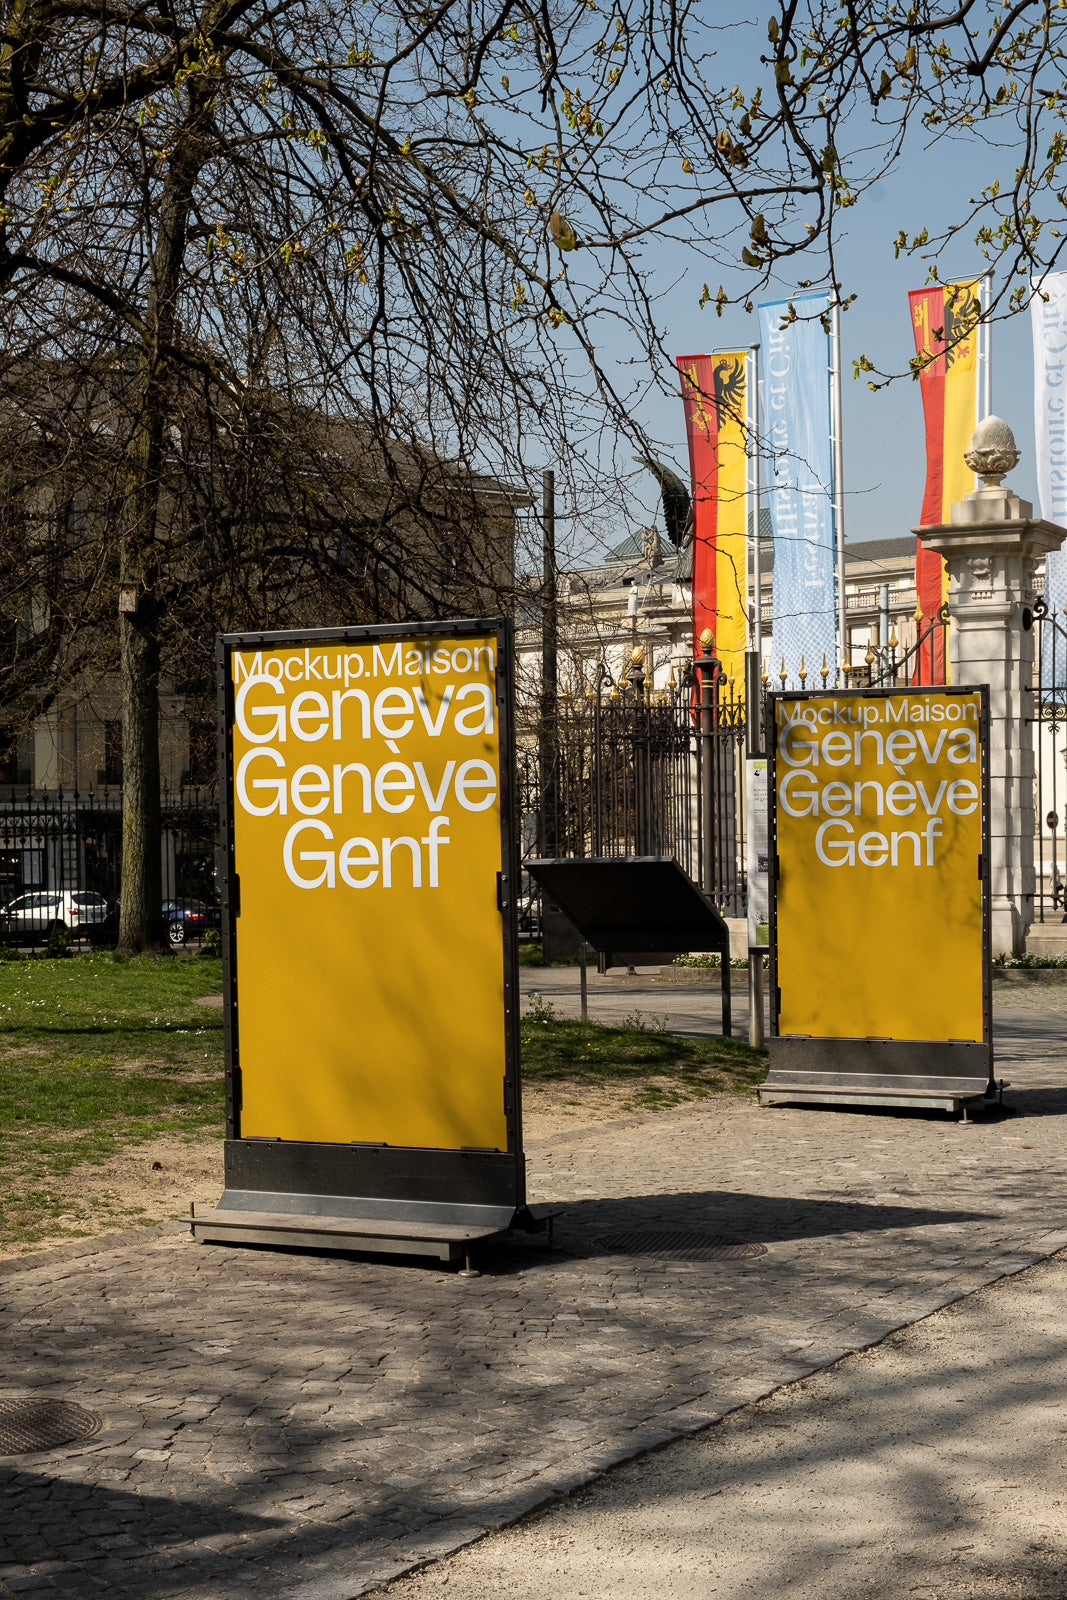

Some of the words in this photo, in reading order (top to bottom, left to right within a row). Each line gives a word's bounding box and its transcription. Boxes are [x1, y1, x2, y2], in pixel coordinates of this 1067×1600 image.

[234, 640, 494, 687] Mockup.Maison
[235, 673, 495, 744] Geneva
[778, 697, 978, 730] Mockup.Maison
[779, 719, 977, 768] Geneva
[236, 739, 497, 817] Genève
[779, 765, 980, 818] Genève
[283, 815, 451, 890] Genf
[814, 817, 943, 867] Genf
